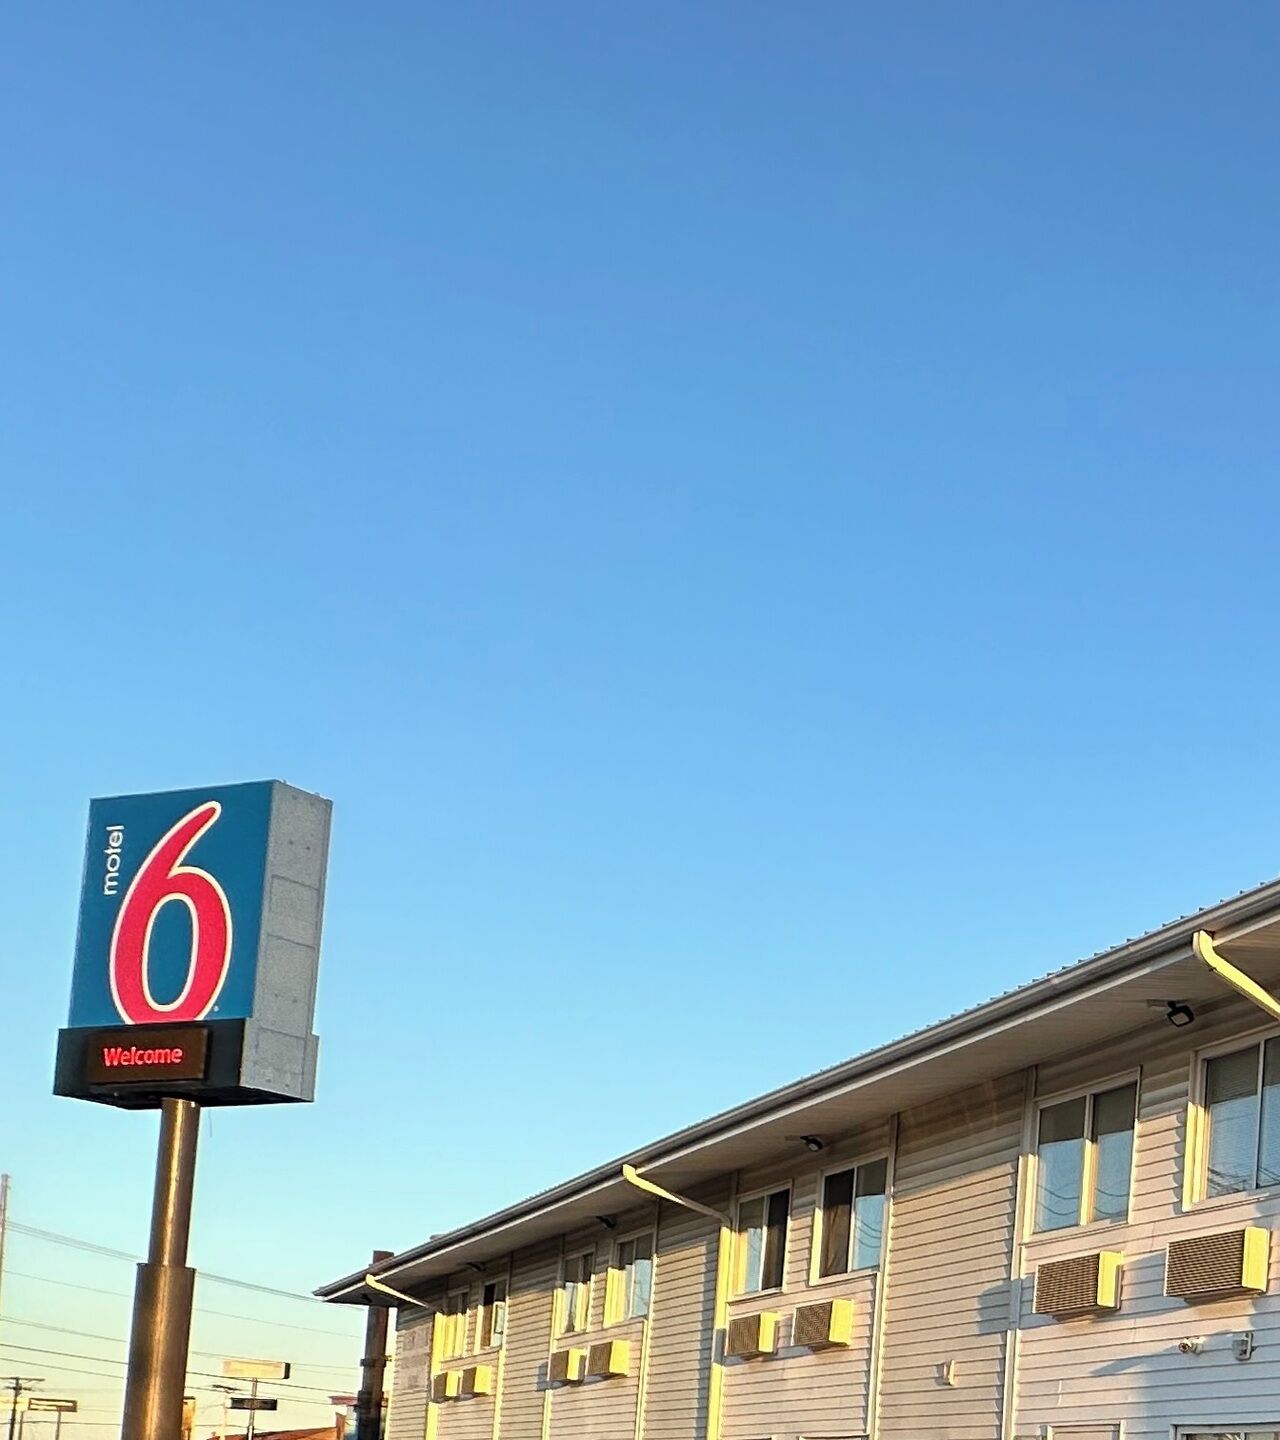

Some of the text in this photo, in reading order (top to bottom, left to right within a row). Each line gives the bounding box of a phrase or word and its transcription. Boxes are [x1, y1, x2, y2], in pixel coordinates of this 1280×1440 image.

[103, 824, 125, 896] motel
[109, 800, 233, 1026] 6
[103, 1045, 183, 1067] Welcome
